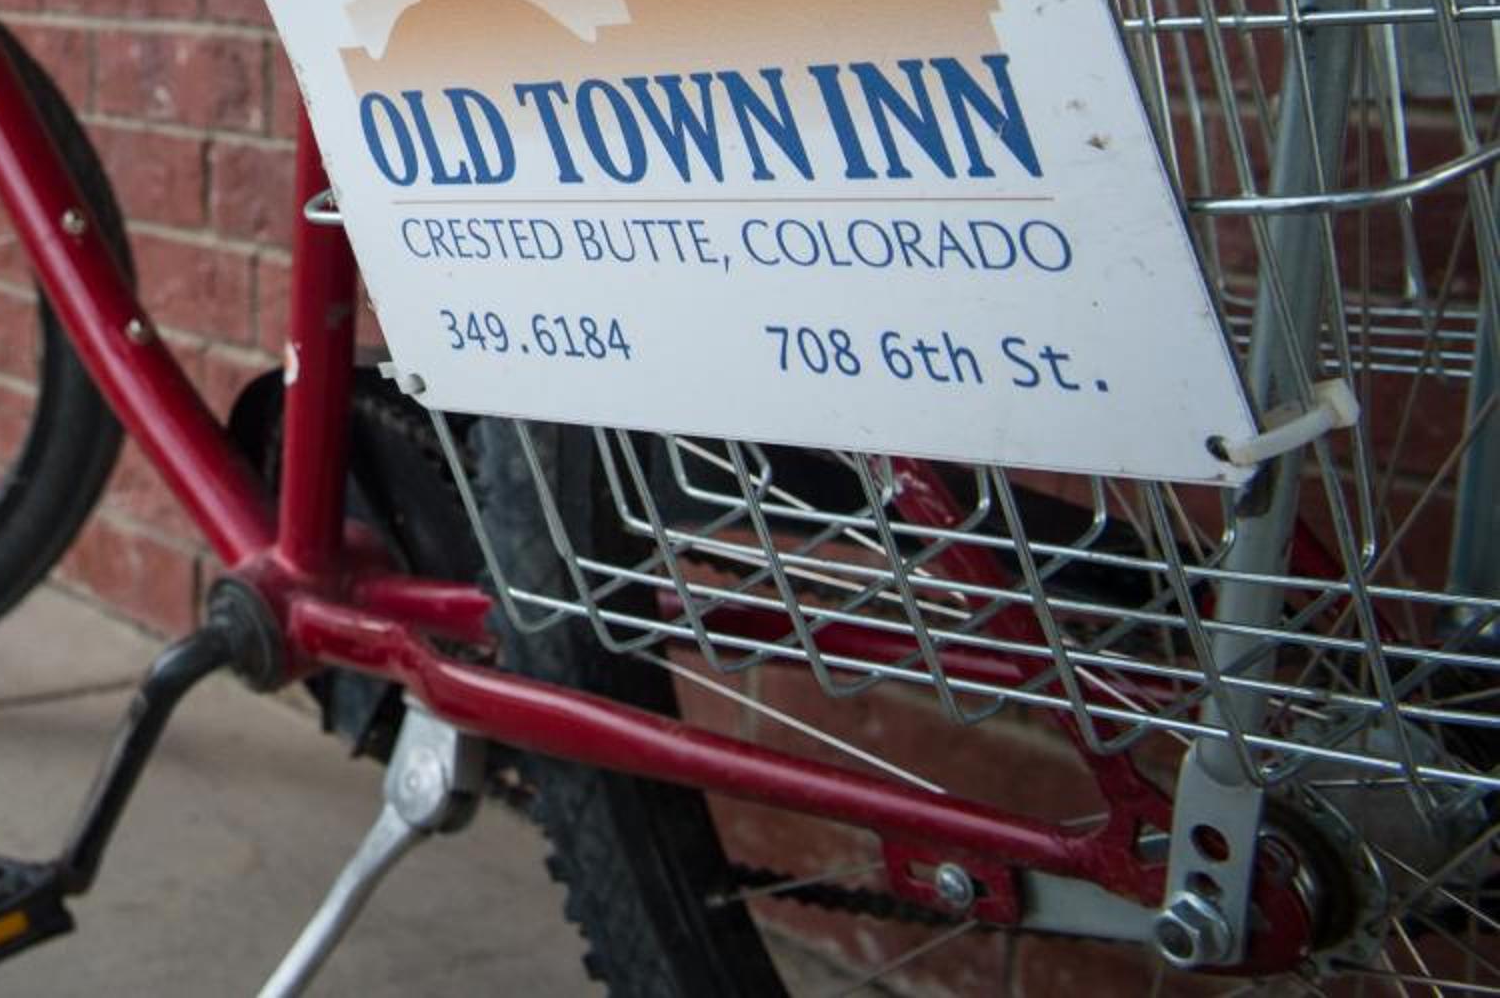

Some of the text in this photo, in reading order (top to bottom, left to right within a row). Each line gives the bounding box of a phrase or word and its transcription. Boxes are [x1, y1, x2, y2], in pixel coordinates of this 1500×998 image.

[359, 53, 1044, 187] OLD TOWN INN
[401, 218, 1073, 273] CRESTED BUTTE, COLORADO
[440, 309, 631, 361] 349.6184
[764, 325, 1109, 394] 708 6th St.
